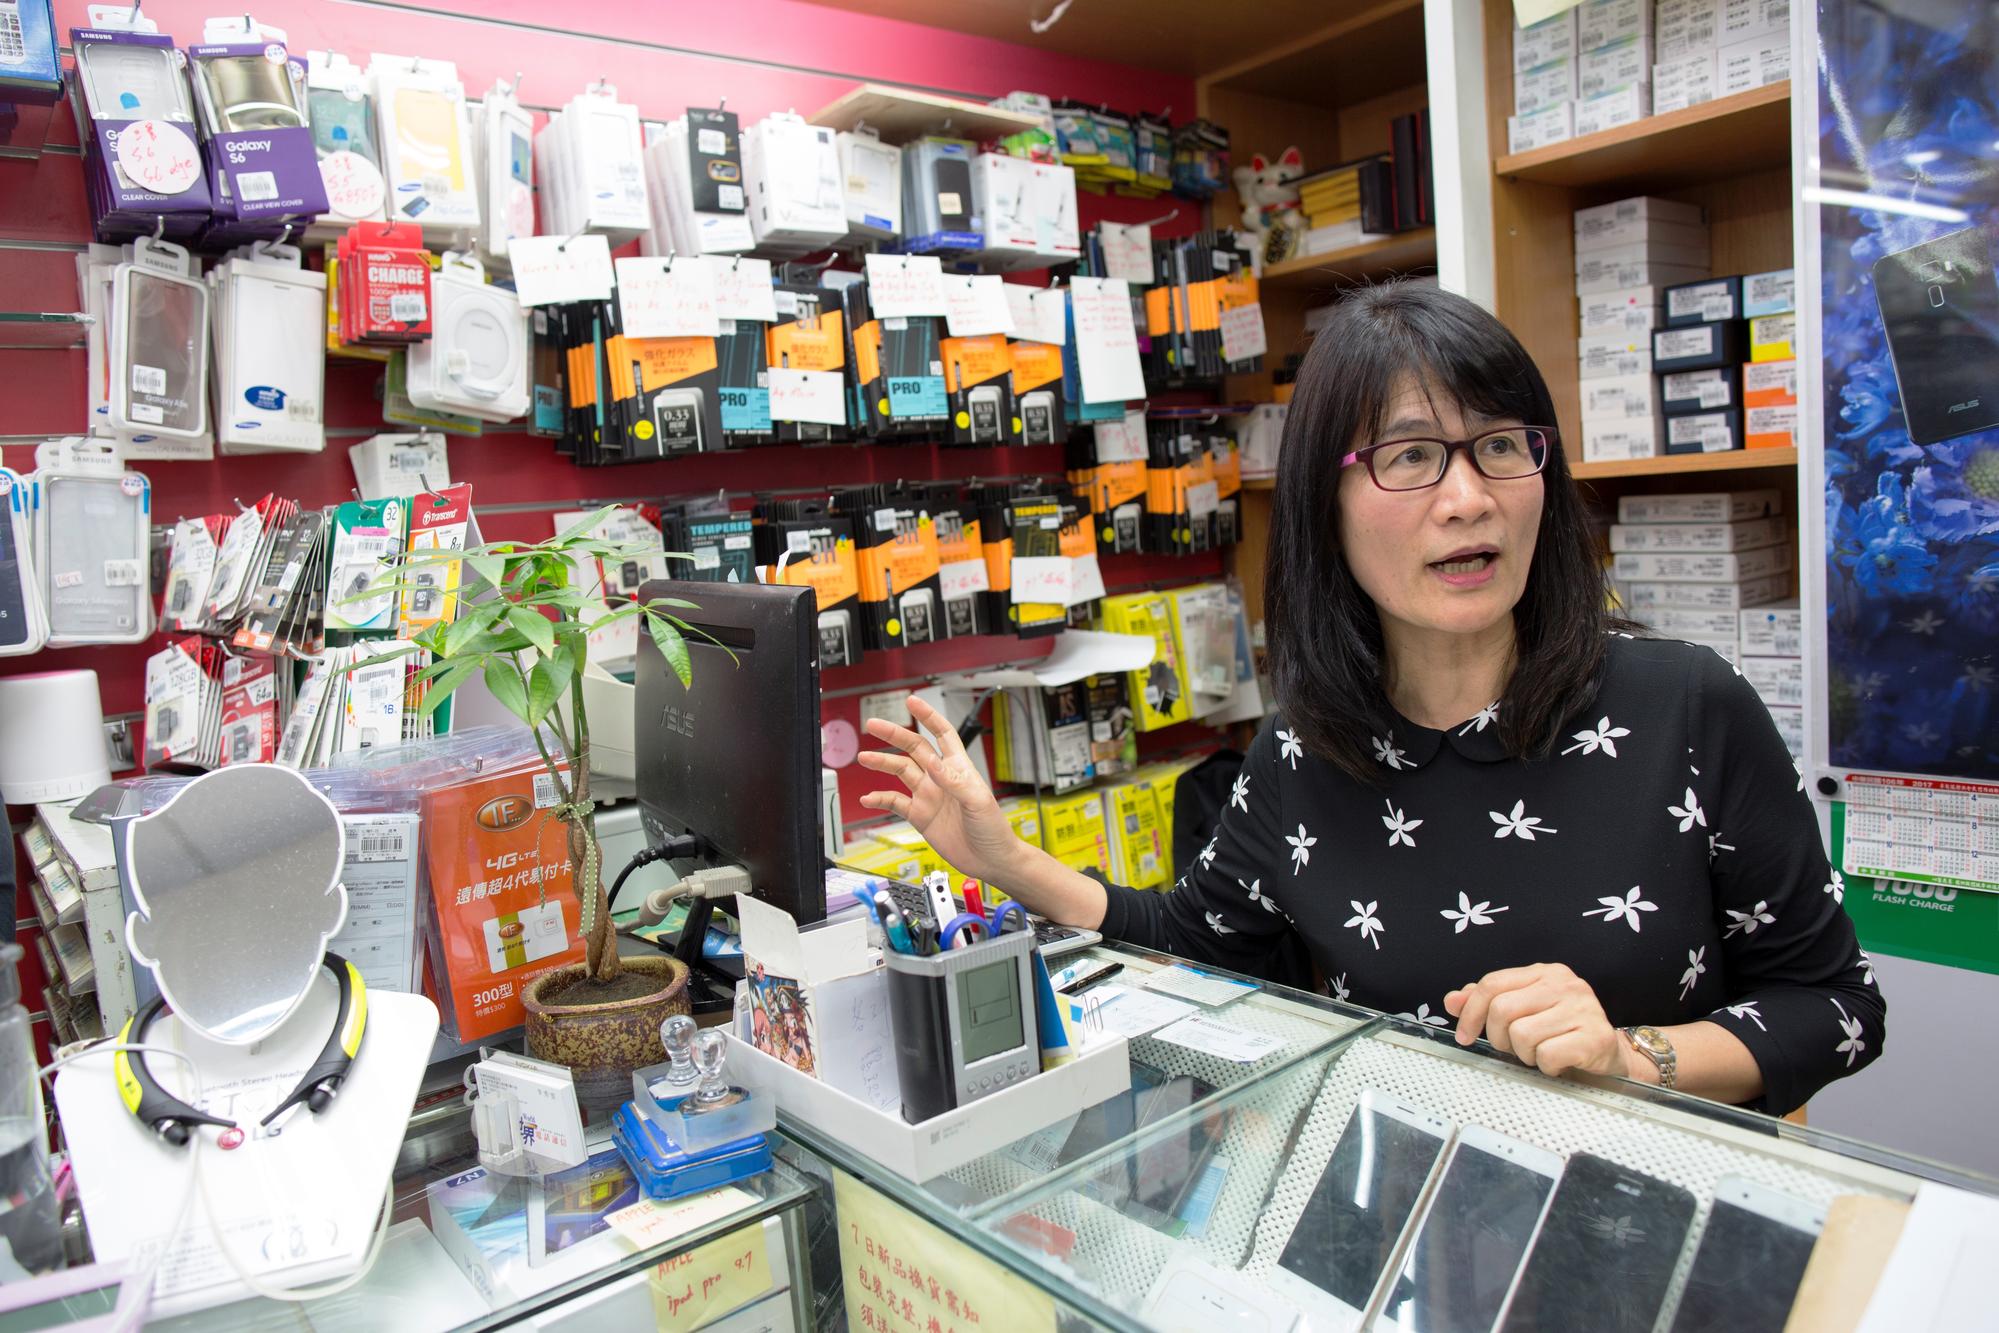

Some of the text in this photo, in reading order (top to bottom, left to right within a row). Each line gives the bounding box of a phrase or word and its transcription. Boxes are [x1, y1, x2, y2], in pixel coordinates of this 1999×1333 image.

[80, 32, 113, 41] SAMSUNG
[225, 139, 271, 153] Galaxy
[229, 153, 246, 165] S6
[121, 193, 169, 202] CLEAR COVER
[243, 198, 304, 212] CLEAR VIEW COVER
[144, 256, 179, 273] SAMSUNG
[367, 267, 425, 285] CHARGE
[891, 381, 921, 395] PRO
[719, 392, 748, 407] PRO
[1947, 398, 1980, 414] ASUS
[663, 409, 690, 421] 0.33
[71, 454, 113, 465] SAMSUNG
[689, 520, 753, 537] TEMPERED
[660, 704, 697, 739] ASUS
[1911, 779, 1934, 789] 2017
[486, 851, 519, 871] 4G
[1872, 893, 1956, 913] FLASH CHARGE
[241, 1074, 273, 1087] Stereo
[657, 1252, 695, 1281] APPLE
[666, 1249, 754, 1318] ipad pro 9.7
